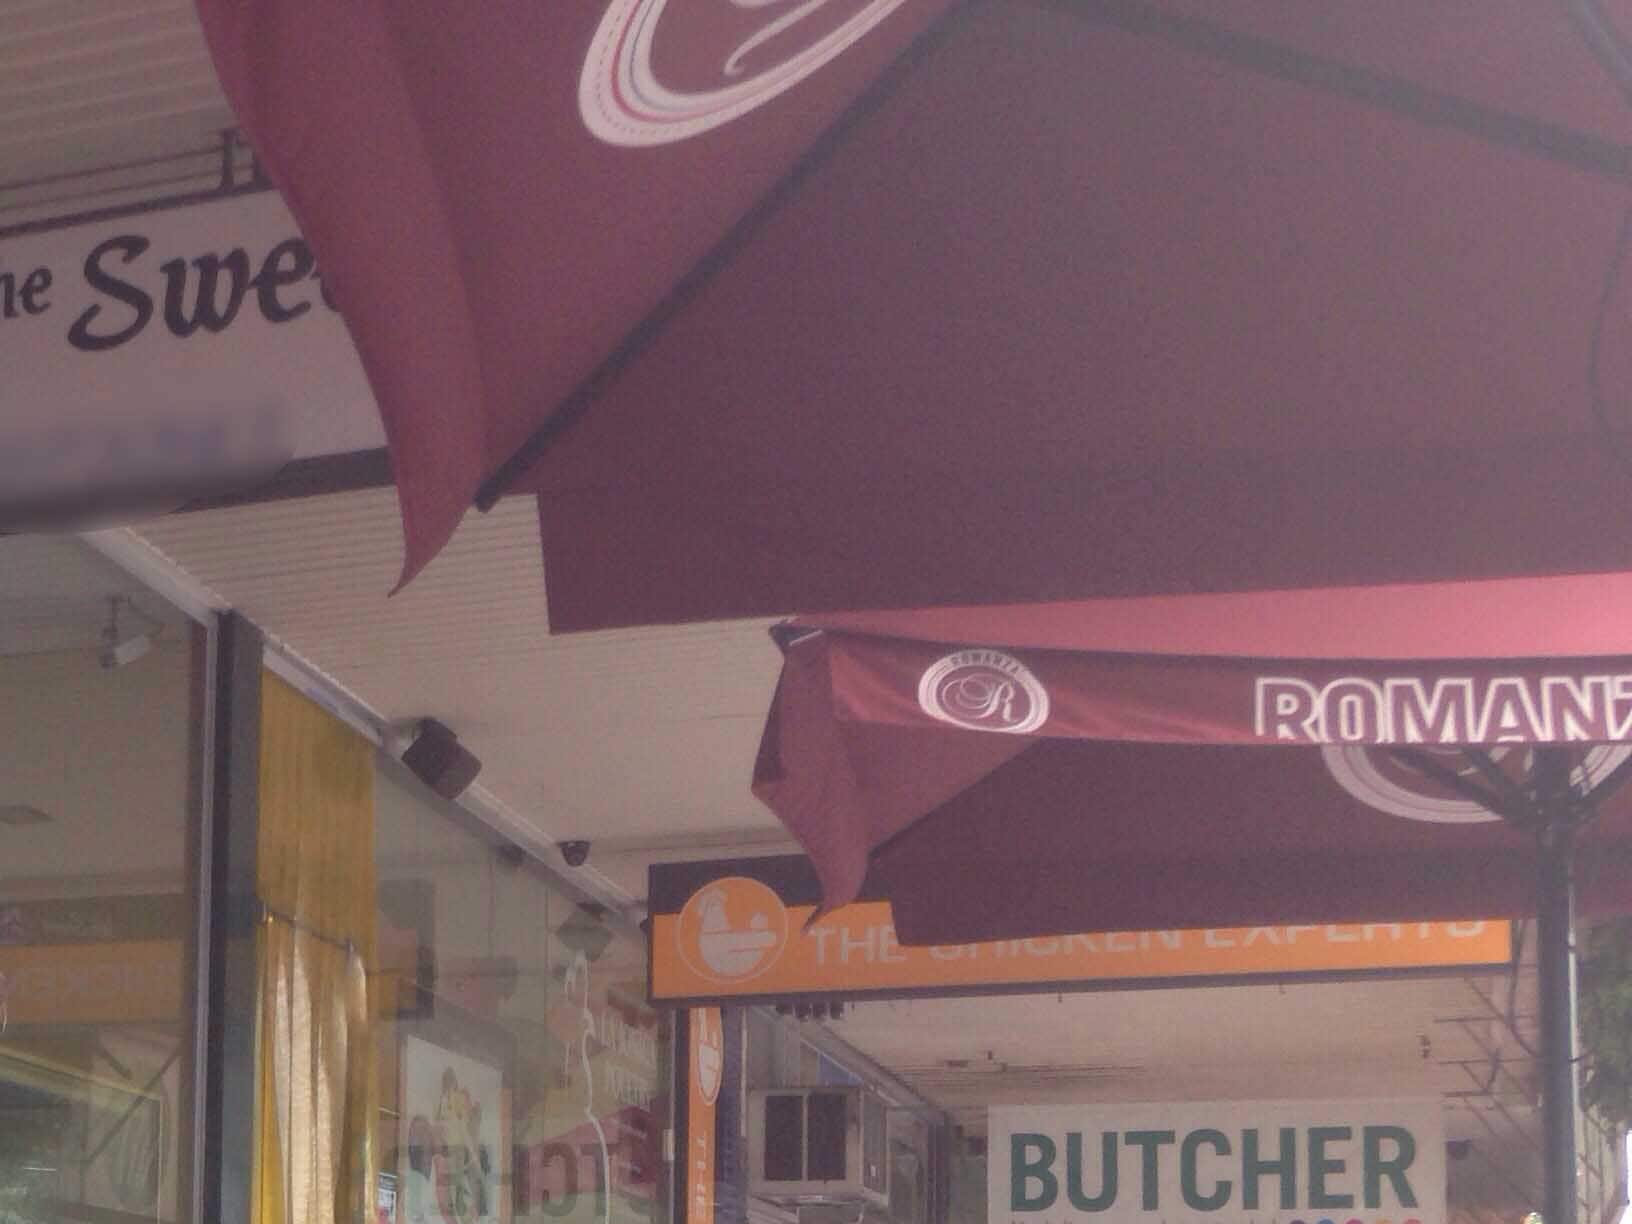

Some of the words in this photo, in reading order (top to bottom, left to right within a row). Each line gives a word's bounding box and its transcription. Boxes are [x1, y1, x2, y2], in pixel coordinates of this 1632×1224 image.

[67, 235, 341, 352] Swe
[808, 925, 906, 963] THE
[1010, 1126, 1419, 1212] BUTCHER
